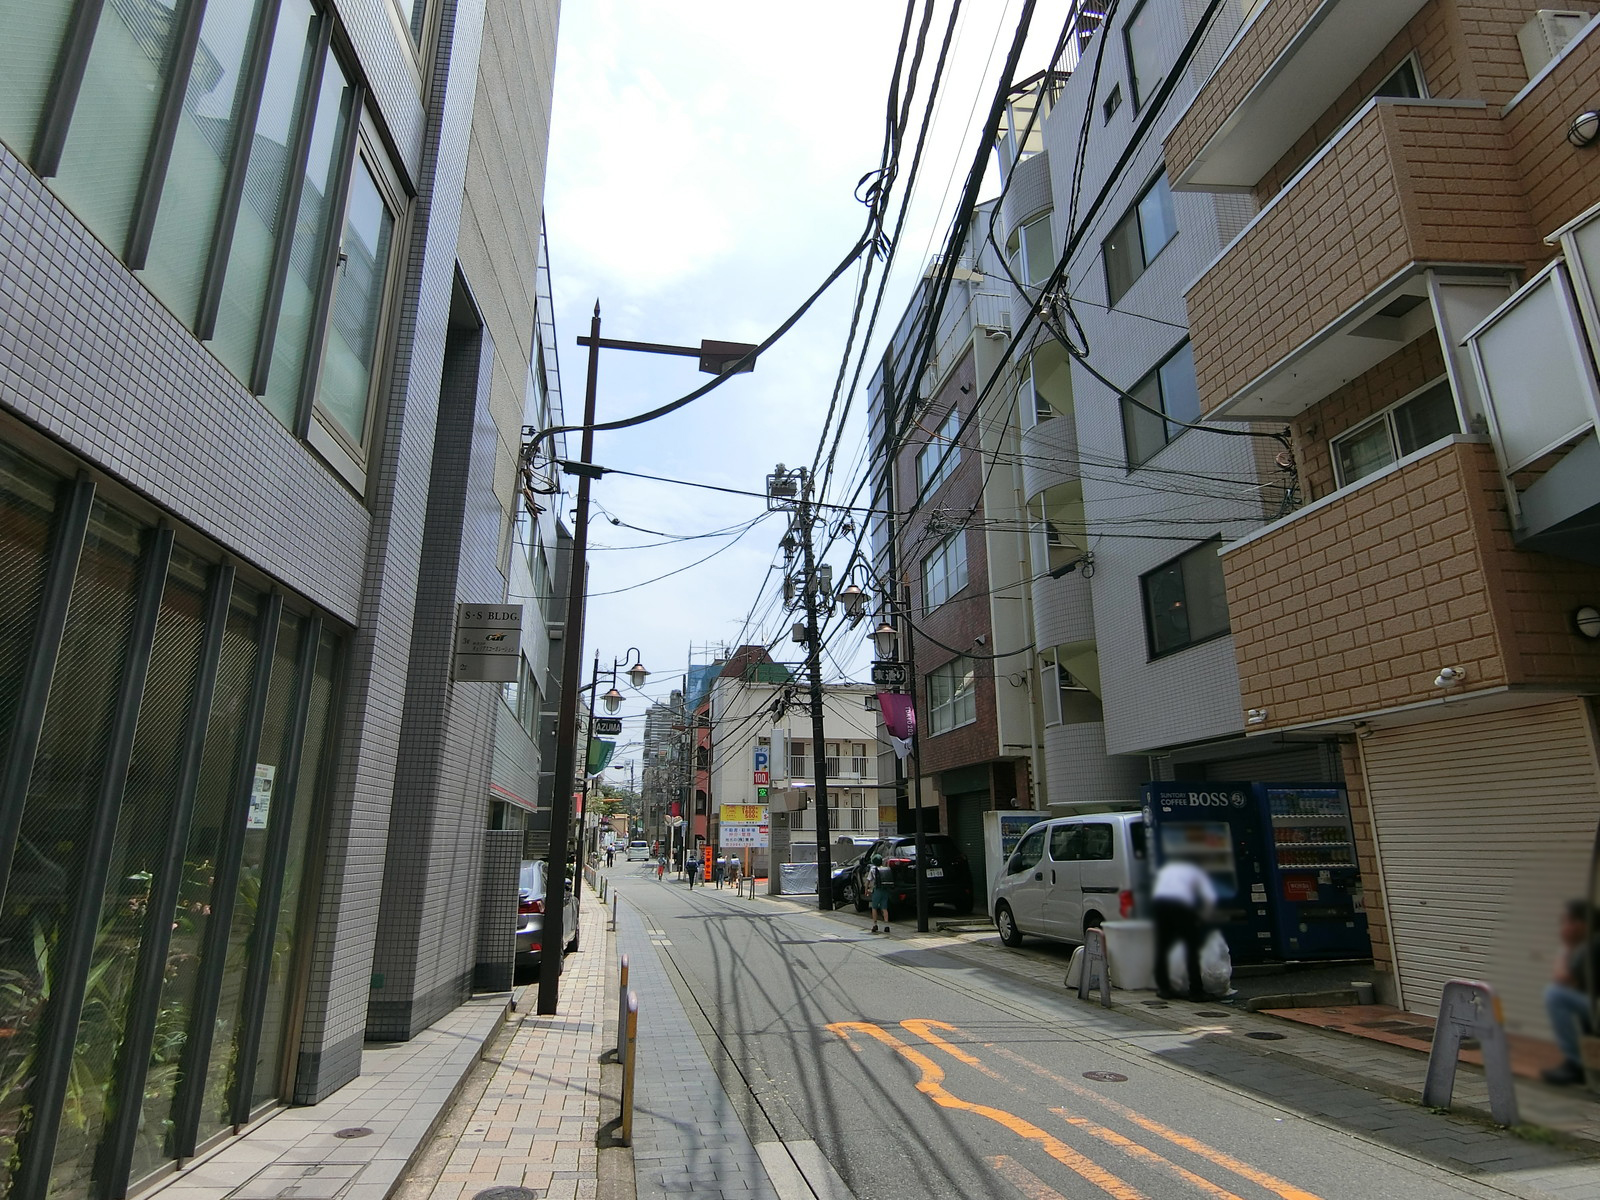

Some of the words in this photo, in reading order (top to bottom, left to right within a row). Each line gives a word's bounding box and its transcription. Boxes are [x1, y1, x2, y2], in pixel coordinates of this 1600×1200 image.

[487, 611, 520, 621] BLDG.
[596, 722, 621, 732] AZUMA
[755, 753, 767, 770] P
[1188, 792, 1229, 806] BOSS
